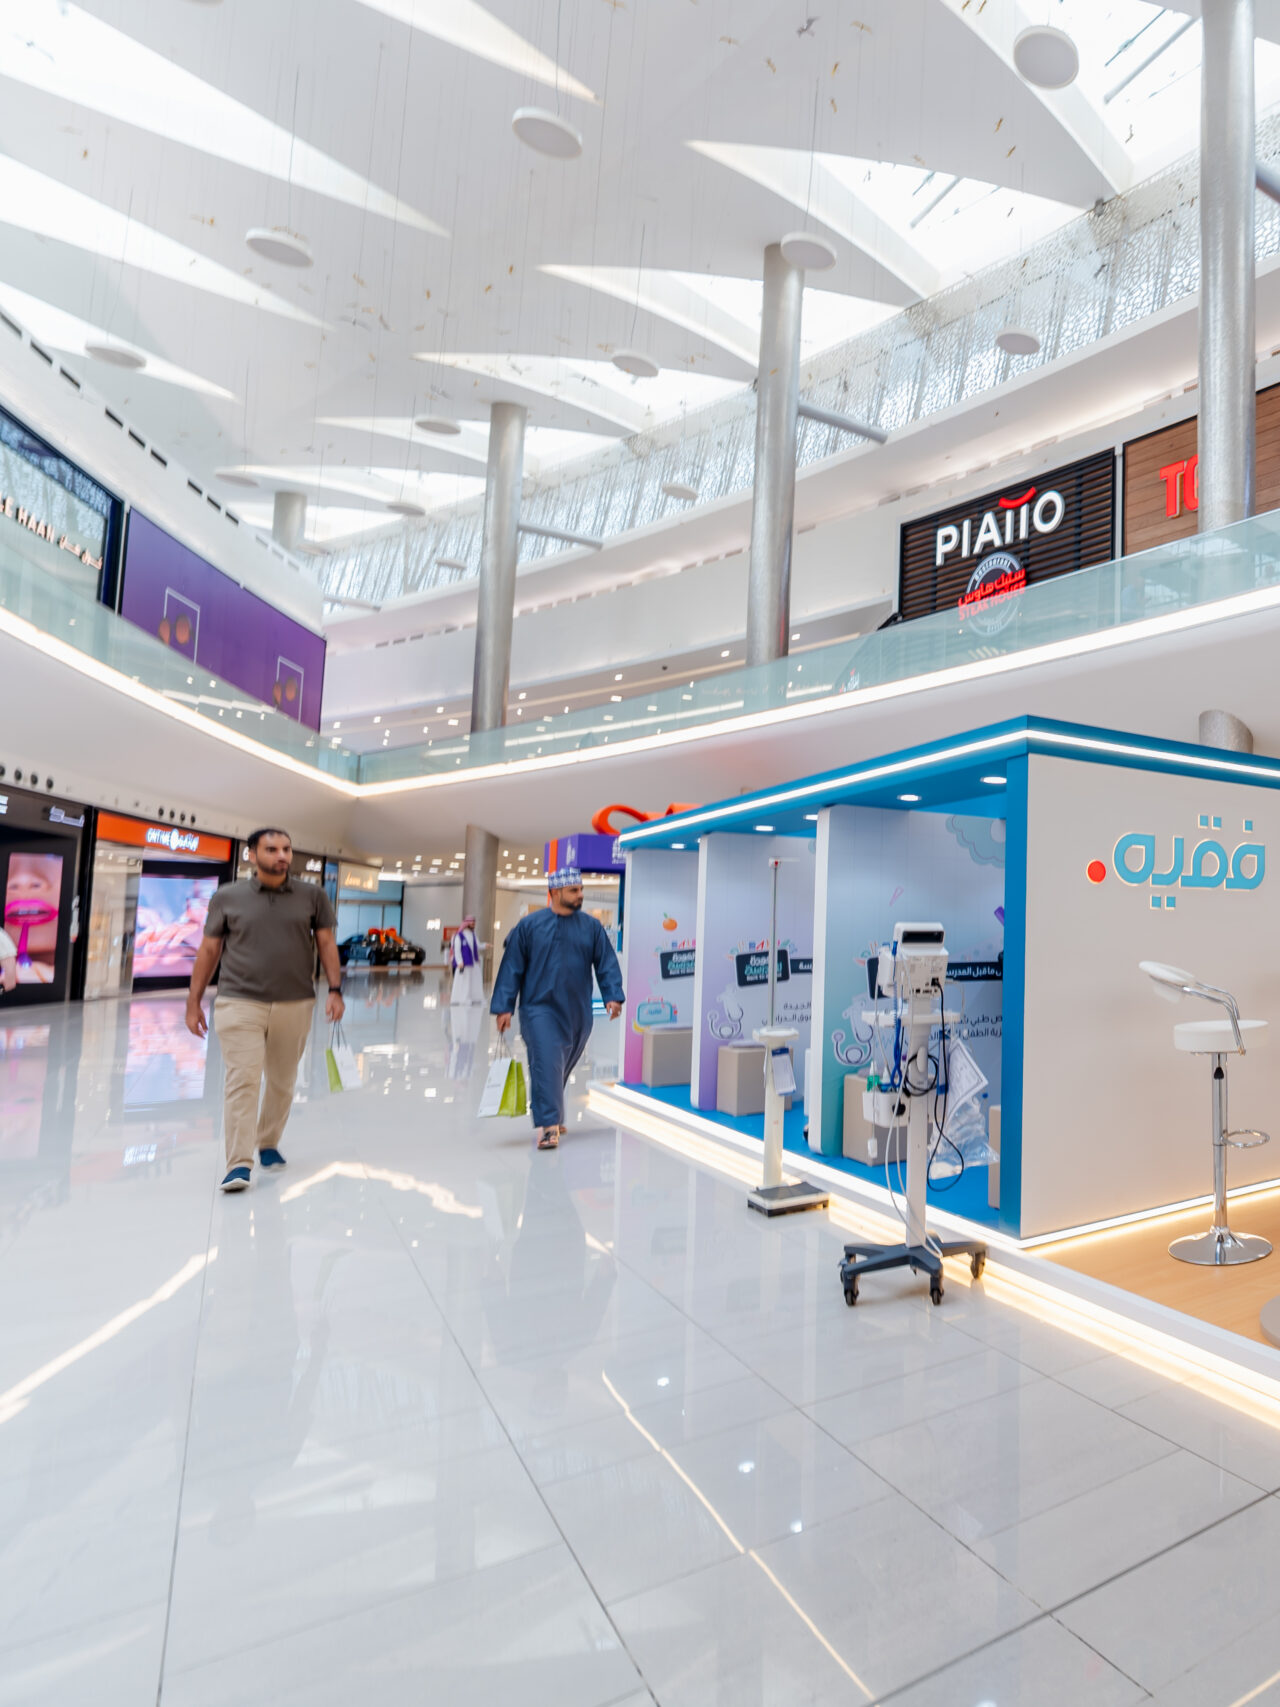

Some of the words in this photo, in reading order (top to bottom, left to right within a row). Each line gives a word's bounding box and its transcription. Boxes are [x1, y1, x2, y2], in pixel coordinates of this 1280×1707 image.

[17, 505, 55, 544] HAAN
[1112, 814, 1266, 910] فقيه
[946, 966, 971, 979] المدرس
